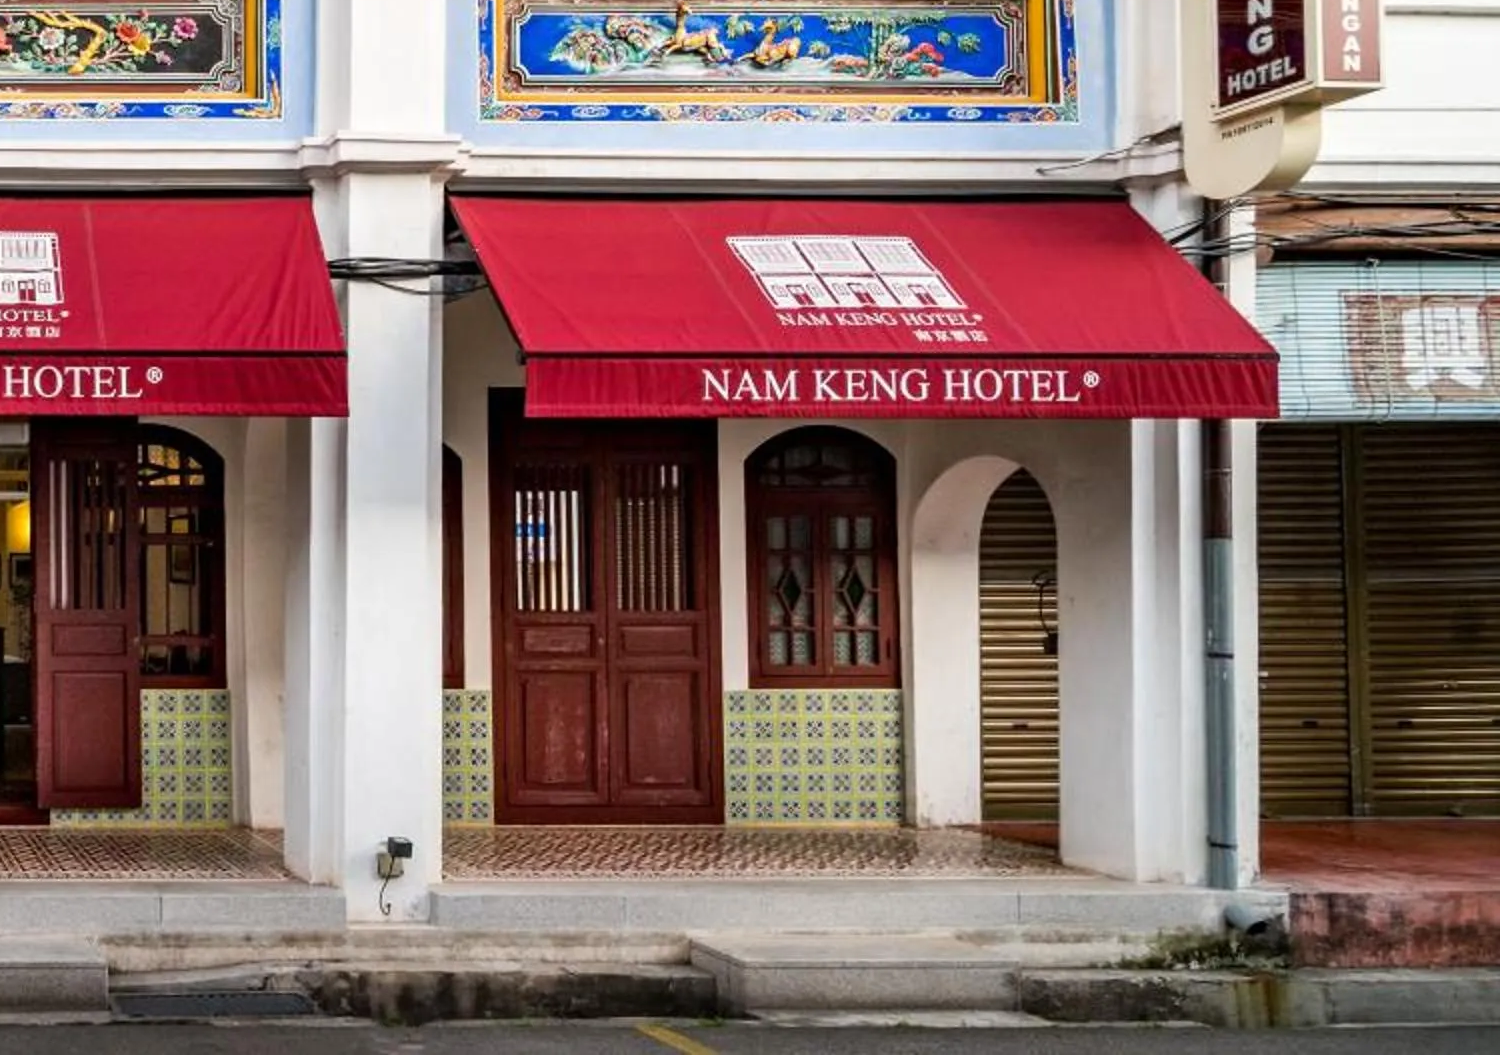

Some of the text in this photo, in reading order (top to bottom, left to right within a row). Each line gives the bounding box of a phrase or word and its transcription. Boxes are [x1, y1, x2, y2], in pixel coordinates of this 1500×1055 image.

[1227, 56, 1297, 96] HOTEL
[776, 312, 833, 327] NAM
[834, 312, 899, 326] KENG
[702, 369, 799, 401] NAM
[813, 368, 931, 402] KENG
